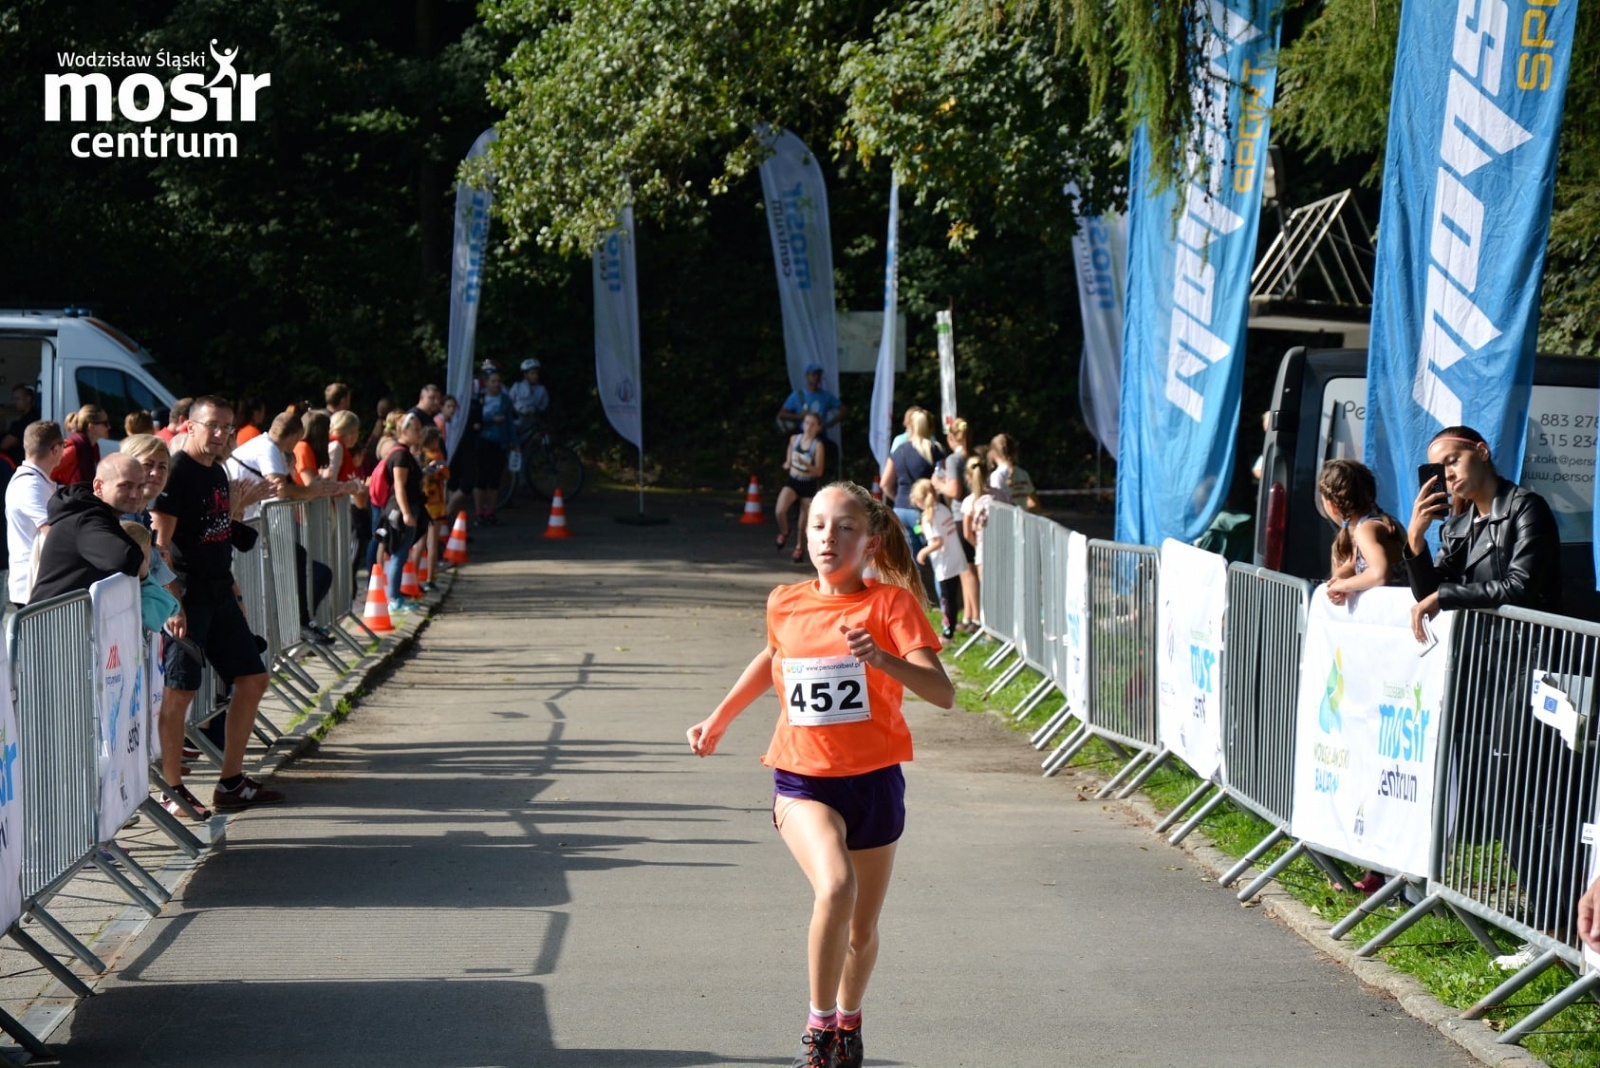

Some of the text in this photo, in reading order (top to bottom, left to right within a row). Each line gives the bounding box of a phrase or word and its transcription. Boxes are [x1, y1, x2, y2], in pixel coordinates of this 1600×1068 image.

[1517, 0, 1559, 91] SP
[1234, 58, 1267, 193] SPORT
[1541, 413, 1569, 427] 883
[1539, 433, 1568, 447] 515
[790, 680, 863, 712] 452
